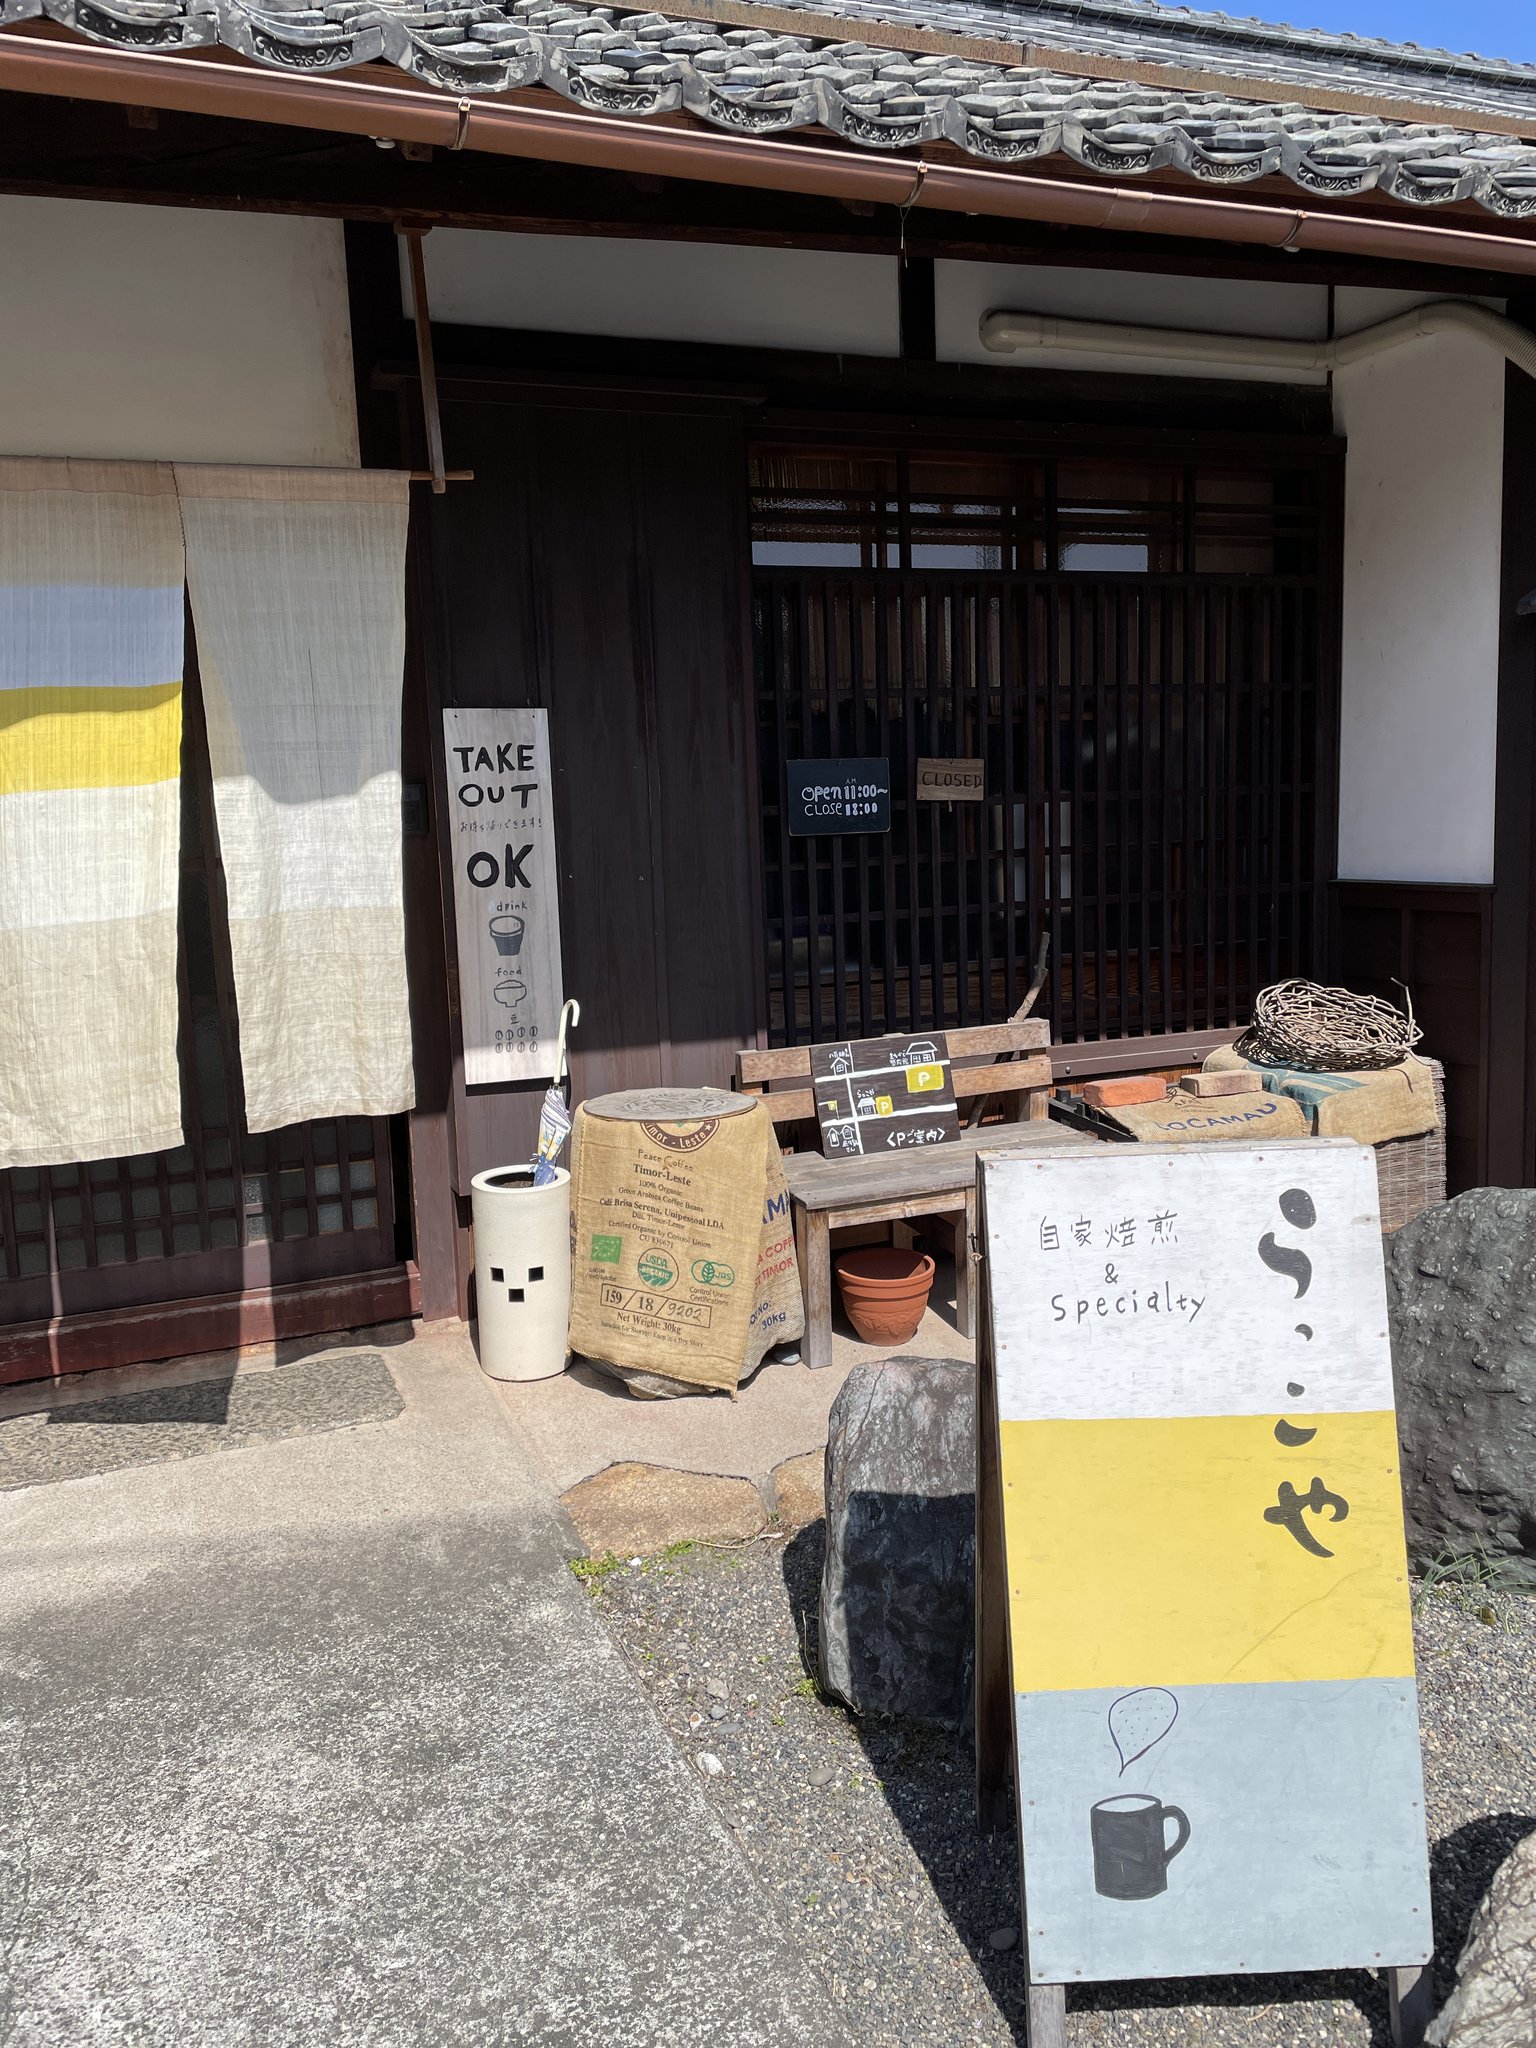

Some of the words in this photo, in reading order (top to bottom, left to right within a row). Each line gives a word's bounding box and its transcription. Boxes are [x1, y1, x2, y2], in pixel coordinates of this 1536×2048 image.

[453, 743, 535, 773] TAKE
[921, 771, 982, 788] CLOSED
[458, 783, 538, 809] OUT
[845, 802, 878, 816] 18:00
[466, 843, 534, 888] OK
[496, 900, 528, 912] drink
[494, 966, 523, 976] food
[918, 1071, 930, 1087] P
[880, 1101, 889, 1113] P
[680, 1132, 706, 1149] Leste
[638, 1149, 662, 1163] Peace
[633, 1163, 691, 1187] Timor-Leste
[639, 1179, 657, 1190] 100%
[658, 1184, 683, 1197] Organic
[618, 1187, 636, 1196] Green
[662, 1196, 684, 1207] Coffee
[685, 1203, 704, 1213] Beans
[614, 1198, 633, 1208] Brisa
[706, 1218, 725, 1230] LDA
[632, 1222, 657, 1234] Organic
[657, 1229, 666, 1238] by
[667, 1231, 691, 1243] Control
[692, 1238, 711, 1249] Union
[1039, 1209, 1179, 1251] 自家焙煎
[645, 1253, 668, 1269] USDA
[762, 1257, 794, 1280] TIMOR
[715, 1272, 732, 1281] JAS
[1104, 1263, 1119, 1284] &
[605, 1289, 622, 1304] 159
[638, 1296, 654, 1312] 18
[689, 1286, 711, 1296] Control
[617, 1312, 630, 1322] Net
[633, 1315, 661, 1329] Weight:
[663, 1321, 681, 1335] 30kg
[762, 1312, 786, 1330] 30kg
[1258, 1188, 1350, 1558] らっこや
